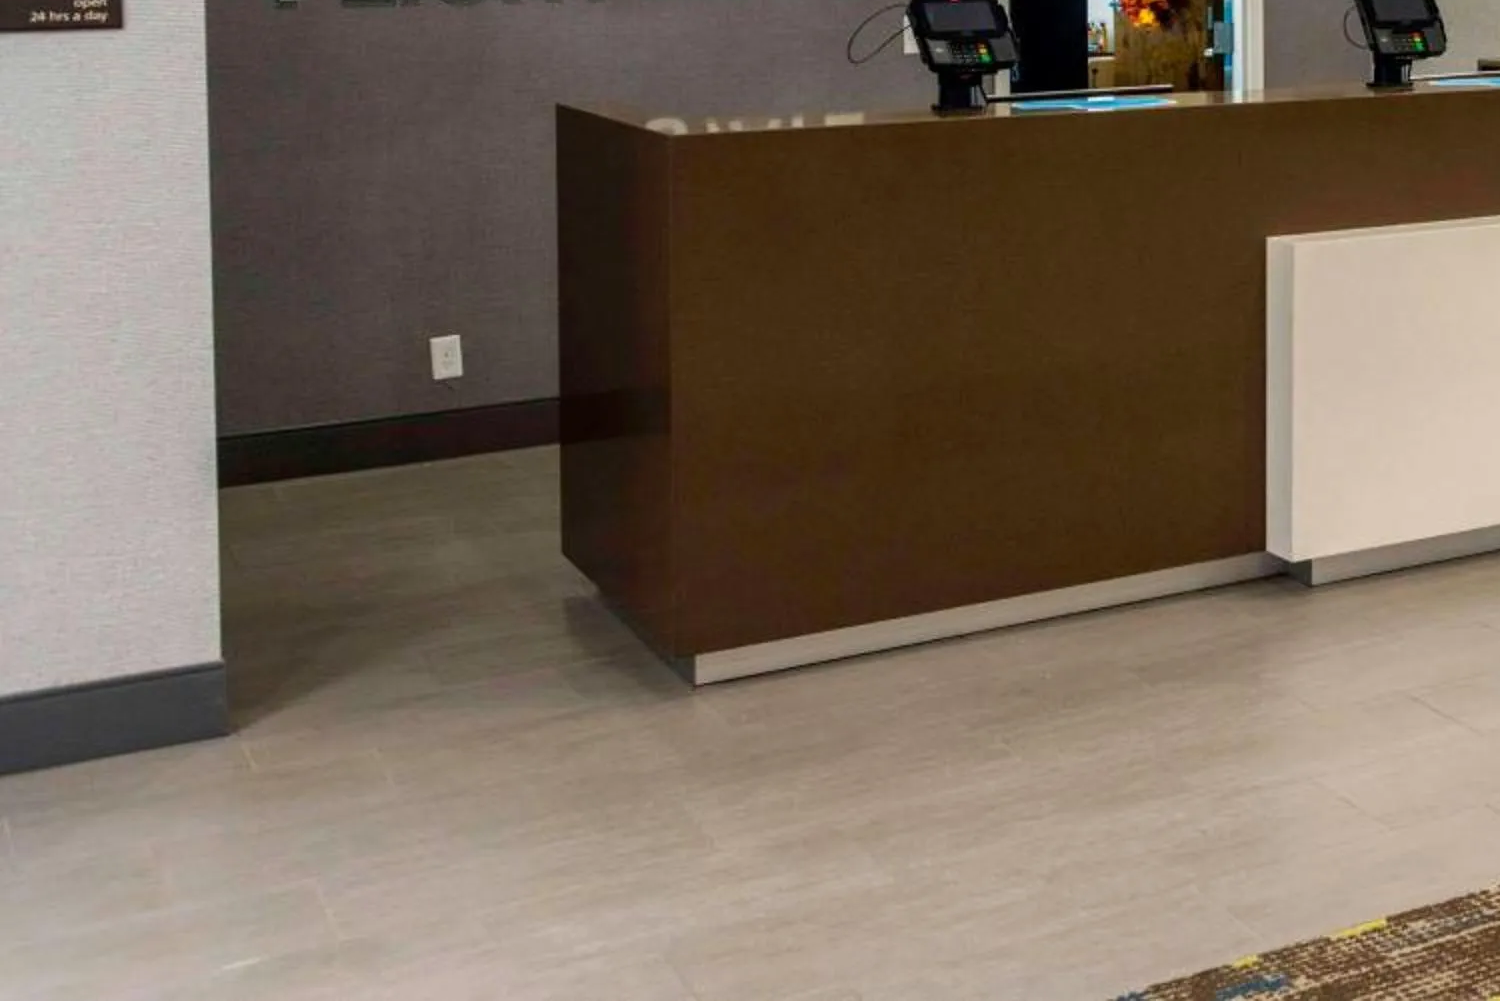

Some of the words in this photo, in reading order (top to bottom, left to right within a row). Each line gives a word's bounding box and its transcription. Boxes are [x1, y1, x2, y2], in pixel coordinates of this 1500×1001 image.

[30, 11, 45, 22] 24
[49, 11, 70, 21] hrs
[72, 12, 81, 21] a
[84, 10, 108, 22] day
